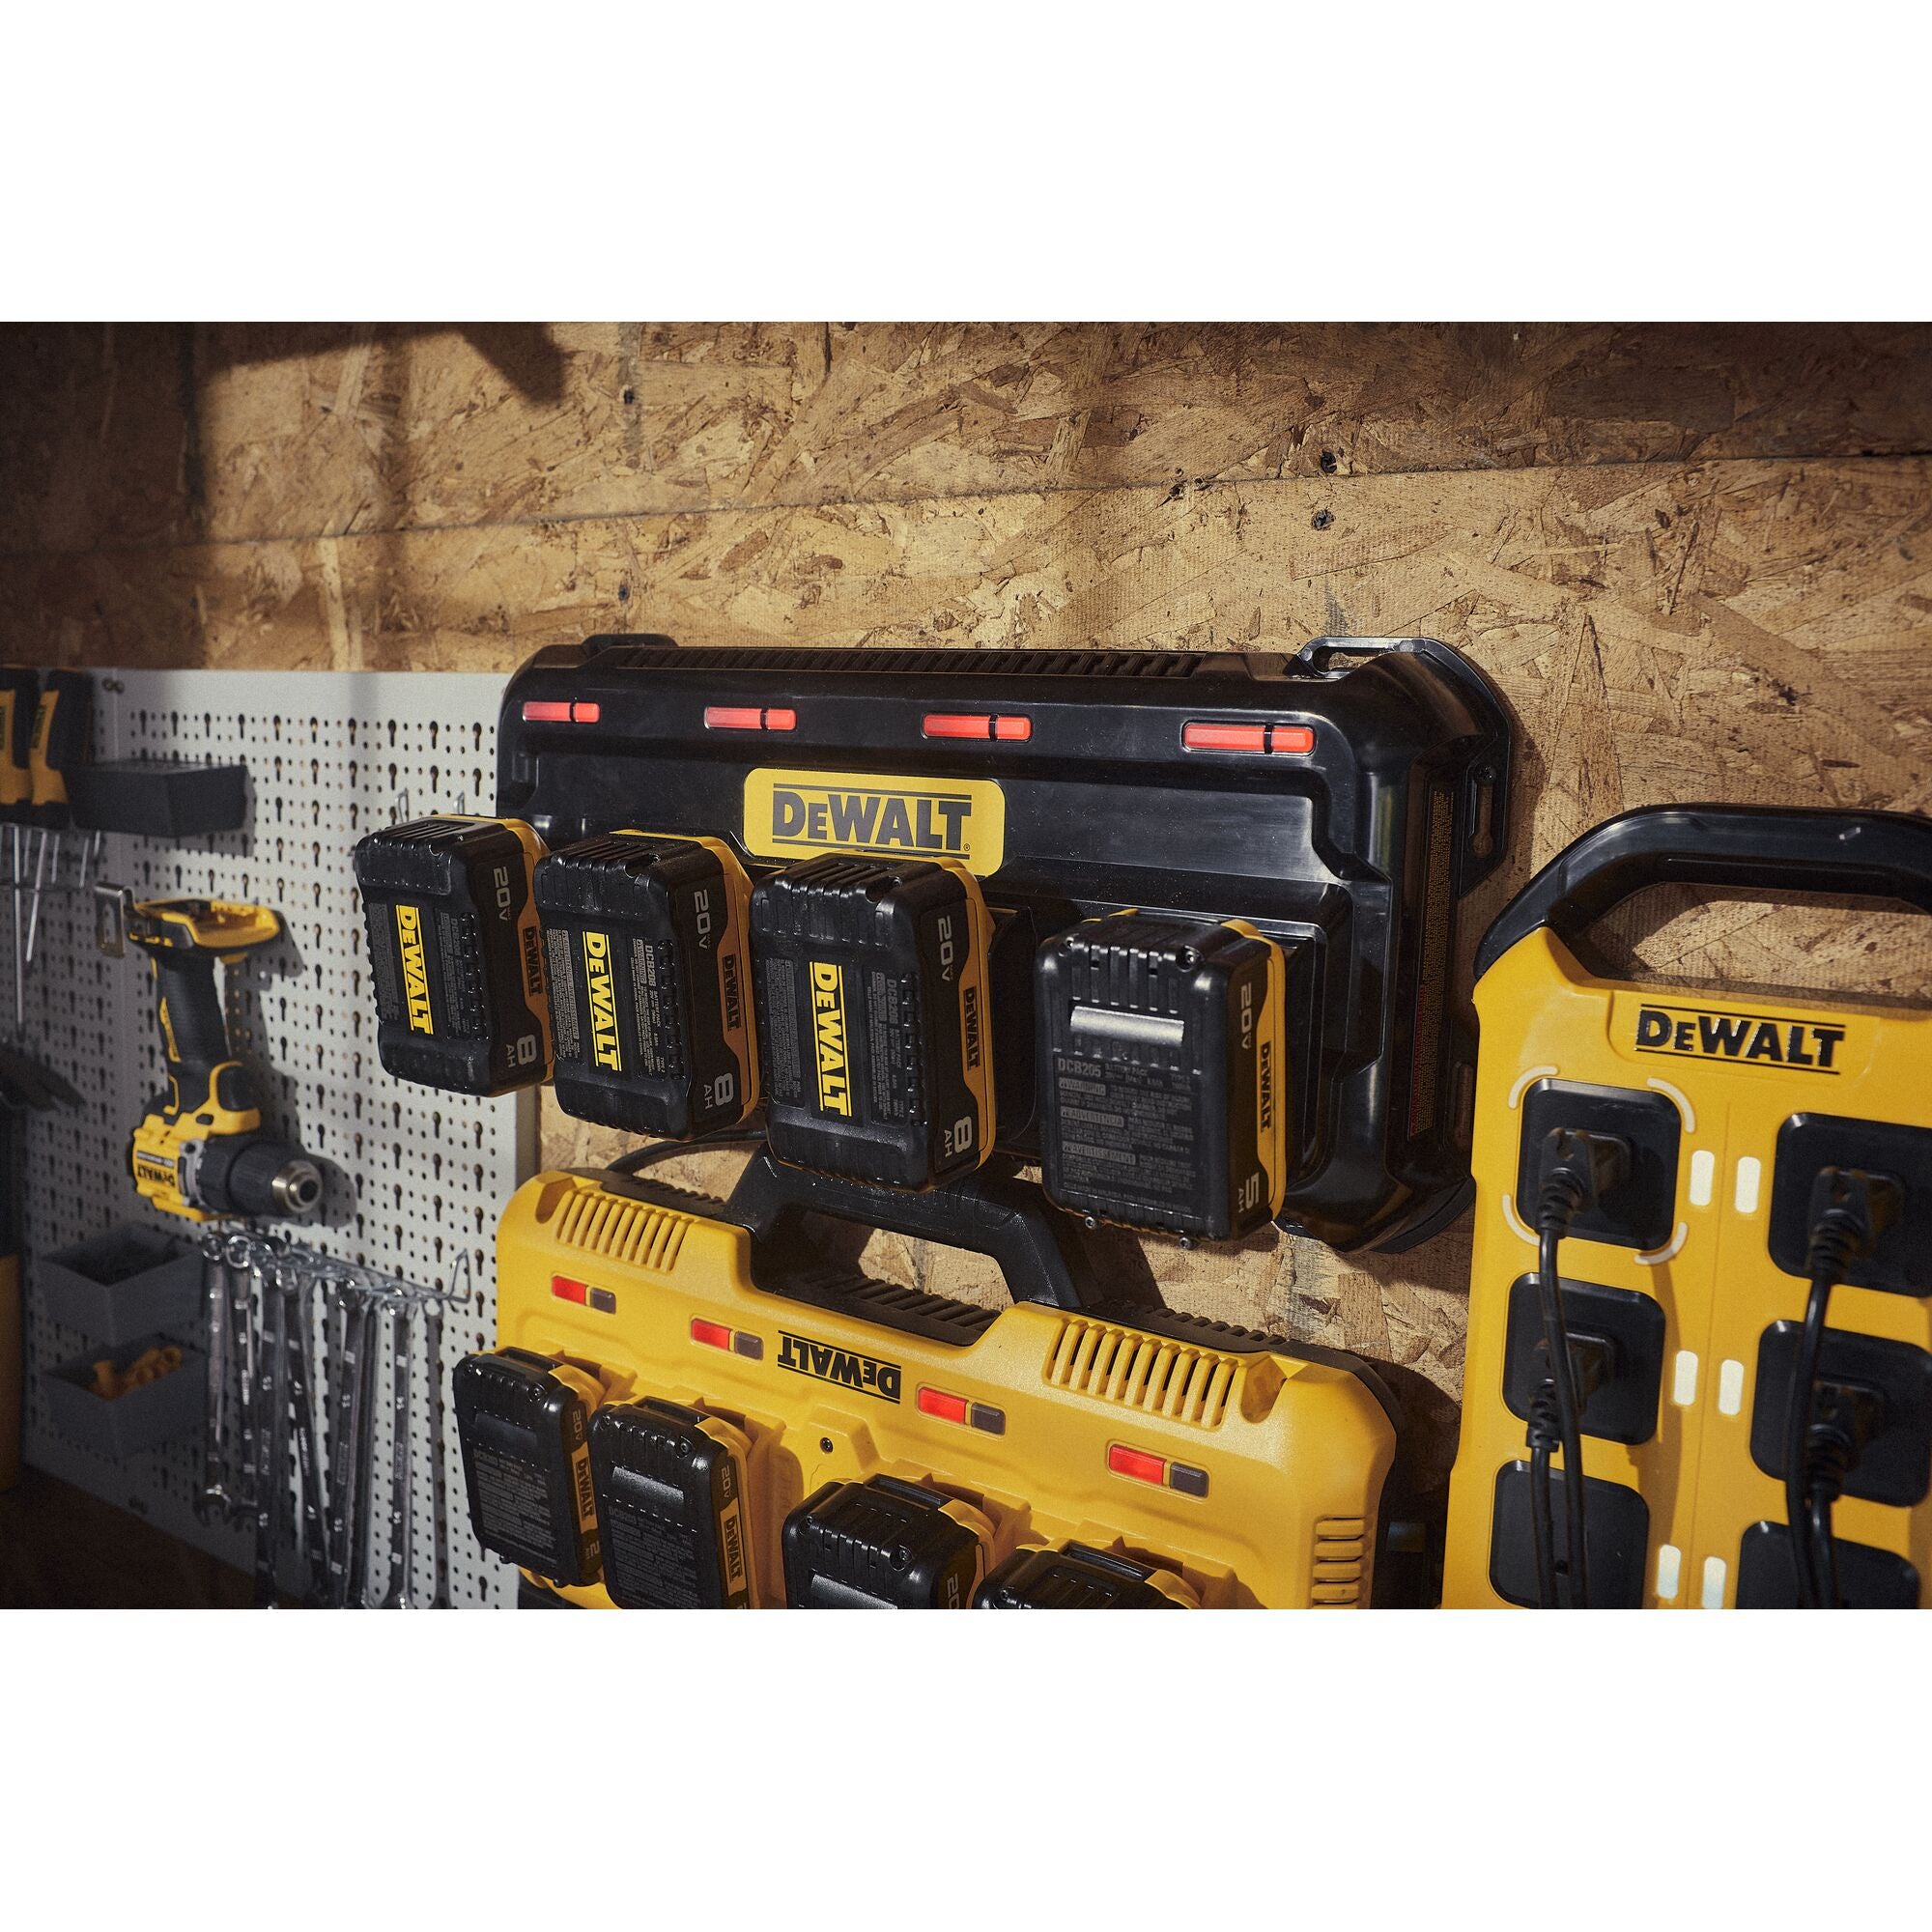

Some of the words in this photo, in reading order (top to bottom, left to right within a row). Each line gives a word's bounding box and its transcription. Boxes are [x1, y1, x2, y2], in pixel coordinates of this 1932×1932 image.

[772, 790, 972, 852] DEWALT
[400, 906, 430, 1034] DEWALT
[525, 927, 543, 994] DEWALT
[645, 945, 657, 986] DCB208
[587, 933, 617, 1069] DEWALT
[724, 954, 740, 1029] DEWALT
[506, 1044, 516, 1067] AH
[517, 1035, 536, 1065] 8
[814, 964, 847, 1115] DEWALT
[964, 987, 980, 1068] DEWALT
[1634, 1009, 1846, 1068] DEWALT
[703, 1084, 713, 1109] AH
[715, 1073, 734, 1106] 8
[1058, 1057, 1101, 1077] DCB205
[1262, 1041, 1271, 1130] DEWALT
[944, 1129, 952, 1157] AH
[954, 1116, 972, 1153] 8
[1246, 1173, 1259, 1208] 5
[777, 1335, 901, 1401] DEWALT
[577, 1458, 592, 1517] DEWALT
[724, 1517, 741, 1578] DEWALT
